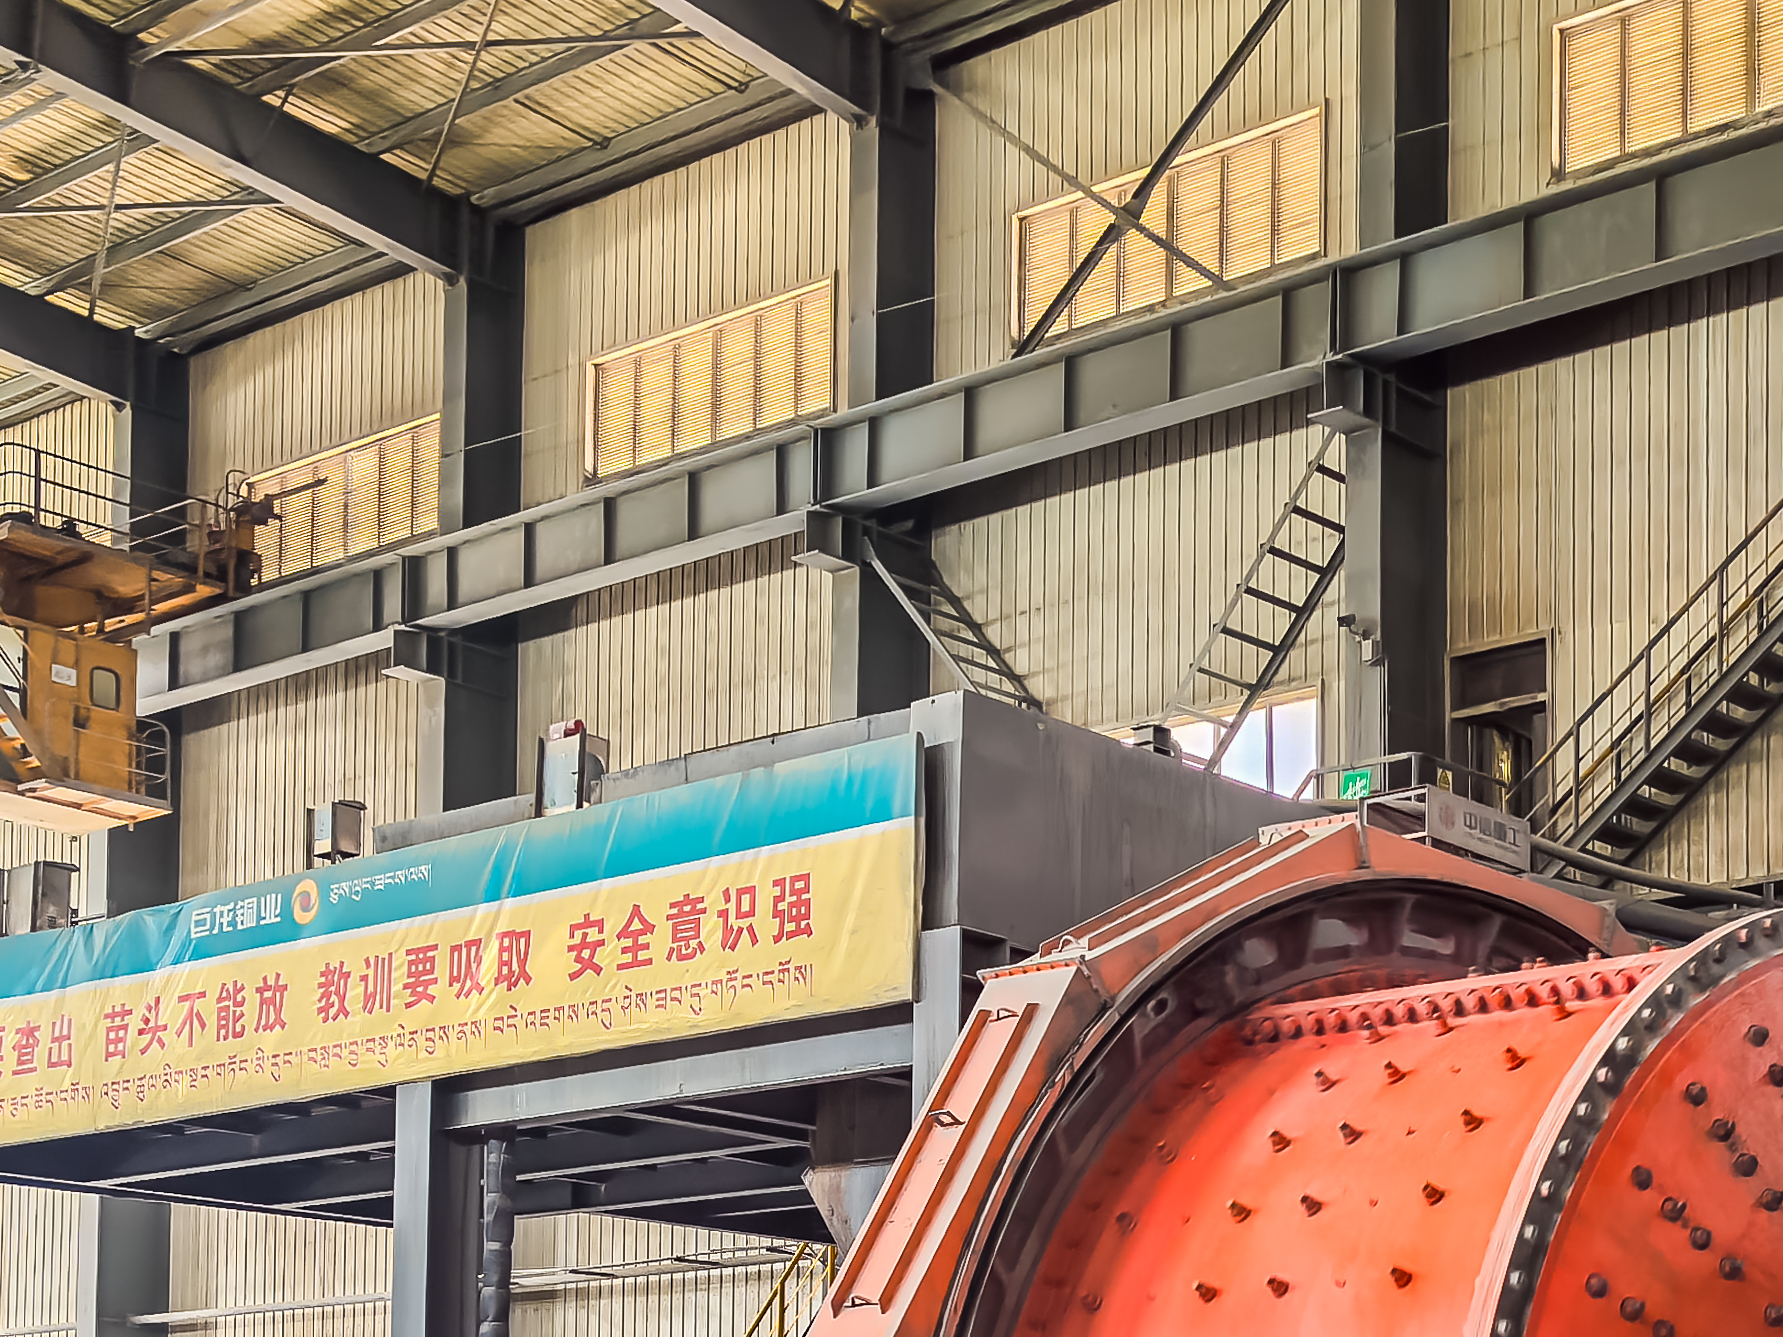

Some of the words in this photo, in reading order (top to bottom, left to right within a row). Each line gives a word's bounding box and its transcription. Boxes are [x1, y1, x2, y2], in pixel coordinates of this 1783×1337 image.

[0, 1014, 73, 1078] 查出
[103, 971, 288, 1062] 苗头不能放
[316, 929, 533, 1024] 教训要吸取
[566, 872, 814, 982] 安全意识强
[190, 893, 282, 938] 巨龙铜业
